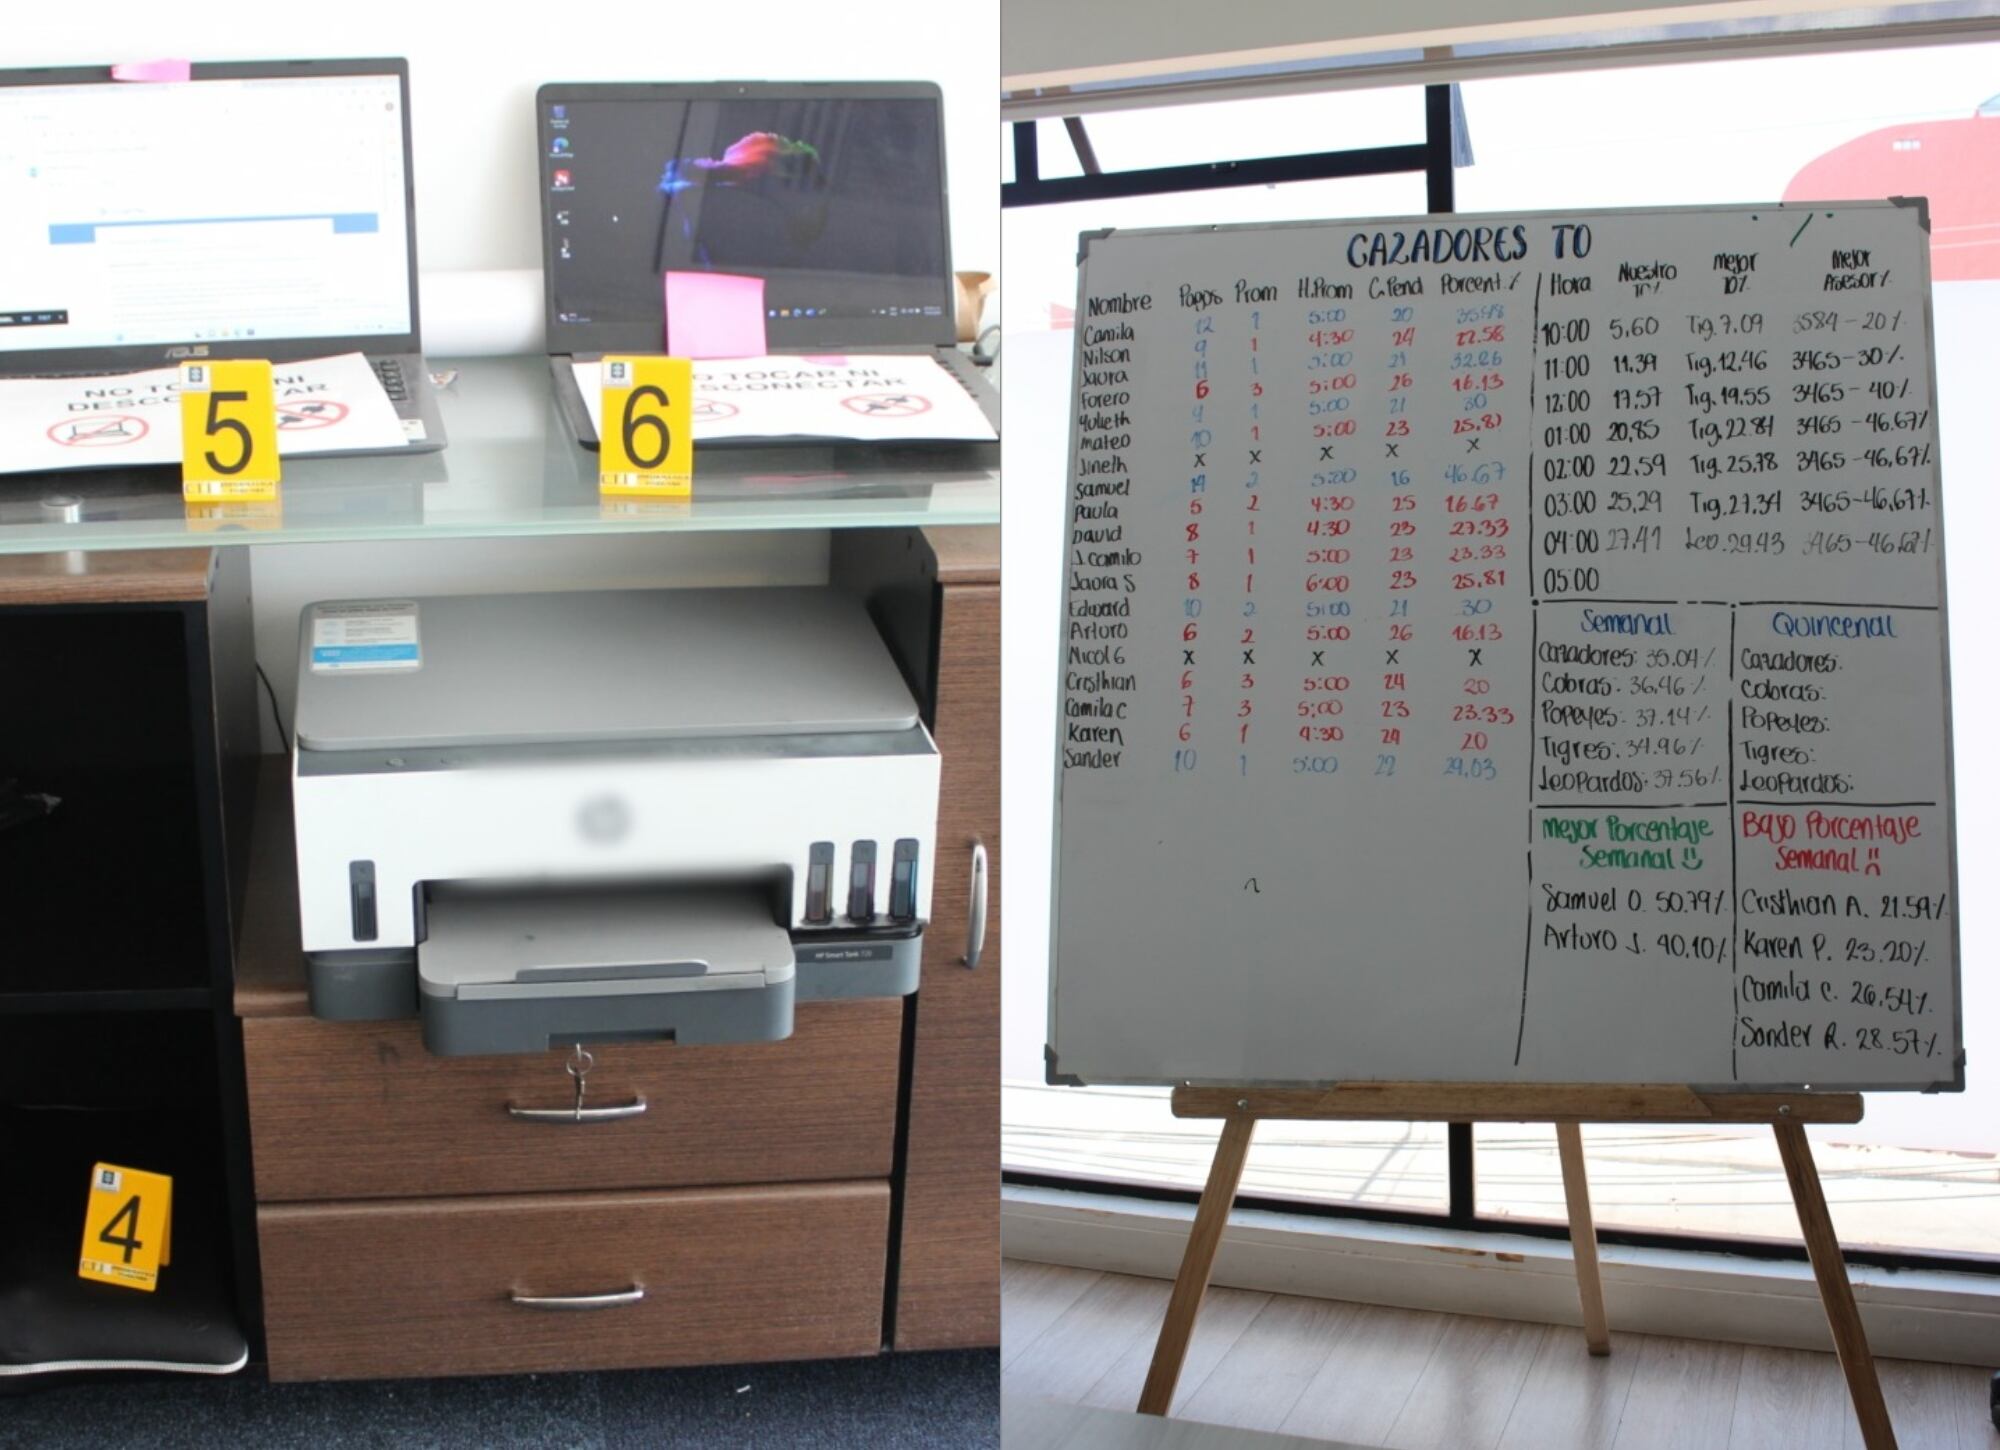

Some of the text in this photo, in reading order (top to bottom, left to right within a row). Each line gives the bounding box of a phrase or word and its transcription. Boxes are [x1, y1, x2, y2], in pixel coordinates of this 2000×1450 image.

[1347, 223, 1592, 268] CAZADORES TO
[1618, 260, 1678, 283] Nuestro
[1088, 292, 1152, 317] Nombre
[1179, 283, 1223, 312] Pagos
[1234, 278, 1277, 303] Prom
[1550, 271, 1592, 297] Hora
[1083, 322, 1135, 347] Camila
[1541, 318, 1591, 347] 10:00
[165, 345, 209, 358] ASUS
[1082, 348, 1131, 368] Nilson
[1308, 329, 1354, 347] 4:30
[722, 370, 836, 381] TOCAR
[849, 368, 880, 378] NI
[1544, 352, 1658, 381] 11:00 11.39
[85, 387, 133, 399] NO
[1081, 391, 1131, 411] Forero
[1251, 382, 1264, 397] 3
[1309, 373, 1357, 394] 5:00
[1388, 373, 1414, 392] 26
[1452, 373, 1505, 392] 16.13
[1545, 389, 1590, 414] 12:00
[205, 390, 253, 475] 5
[621, 384, 670, 469] 6
[1313, 419, 1357, 438] 5:00
[1385, 420, 1411, 437] 23
[1544, 423, 1591, 448] 01:00
[1079, 455, 1129, 477] Jineth
[1544, 455, 1595, 482] 02:00
[1074, 478, 1130, 501] Samuel
[1190, 499, 1203, 516] 5
[1246, 495, 1260, 511] 2
[1311, 496, 1355, 513] 4:30
[1392, 494, 1417, 512] 25
[1544, 490, 1597, 518] 03:00
[1185, 523, 1200, 542] 8
[1306, 518, 1351, 537] 4:30
[1544, 529, 1599, 556] 04:00
[1186, 544, 1507, 565] 7 5:00 23 23.33
[1188, 571, 1201, 591] 8
[1246, 574, 1254, 593] 1
[1306, 574, 1350, 593] 6:00
[1389, 570, 1418, 590] 23
[1452, 570, 1507, 590] 25.81
[1543, 567, 1600, 594] 05:00
[1069, 597, 1130, 618] Edward
[1070, 622, 1504, 644] Arturo 6 2 5:00 26 16.13
[1580, 608, 1676, 636] Semanal
[1772, 611, 1898, 639] Quincenal
[1181, 670, 1194, 690] 6
[1240, 673, 1255, 689] 3
[1303, 676, 1351, 692] 5:00
[1384, 673, 1406, 690] 24
[1464, 678, 1491, 695] 20
[1182, 695, 1196, 718] 7
[1237, 699, 1252, 717] 3
[1381, 700, 1411, 718] 23
[1453, 704, 1516, 725] 23.33
[1068, 722, 1125, 747] Karen
[1179, 722, 1192, 742] 6
[1240, 723, 1249, 744] 1
[1299, 725, 1345, 742] 4:30
[1461, 731, 1489, 751] 20
[1064, 748, 1122, 769] Sander
[1174, 750, 1197, 772] 10
[1240, 755, 1248, 777] 1
[1605, 815, 1714, 845] Porcentaje
[1742, 810, 1922, 845] Bajo Porcentaje
[1579, 845, 1677, 870] Semanal
[1775, 846, 1859, 873] Semanal
[1542, 883, 1617, 913] Samuel
[1741, 888, 1870, 919] Cristhian A.
[1544, 922, 1617, 951] Arturo
[1743, 928, 1803, 960] Karen
[1811, 933, 1832, 962] P.
[825, 951, 844, 959] Smart
[845, 950, 859, 958] Tank
[1742, 969, 1811, 1002] Camila
[98, 1194, 143, 1264] 4
